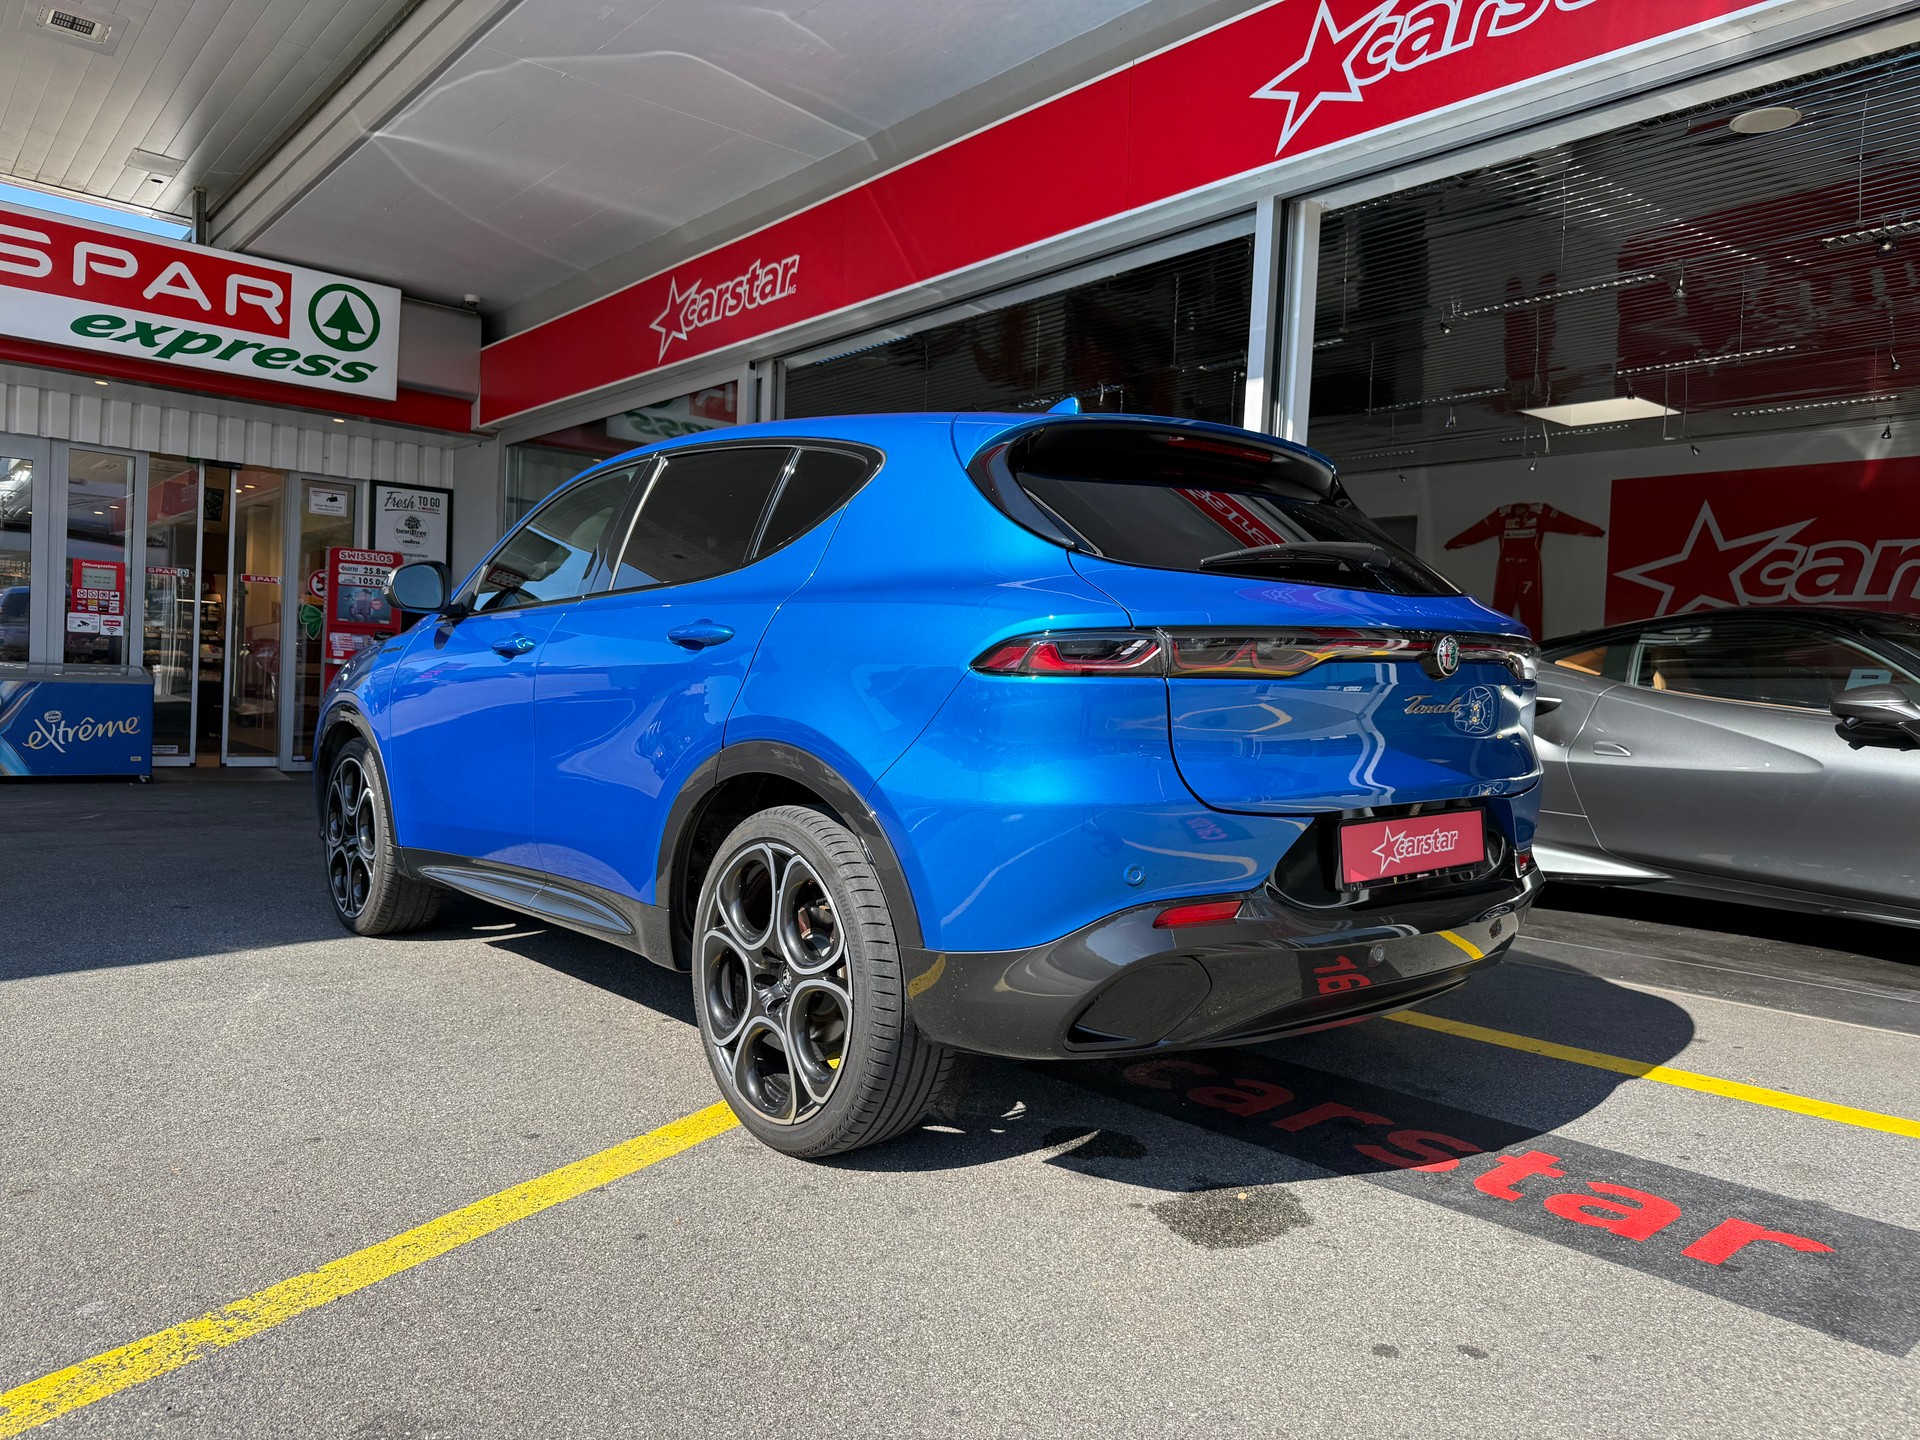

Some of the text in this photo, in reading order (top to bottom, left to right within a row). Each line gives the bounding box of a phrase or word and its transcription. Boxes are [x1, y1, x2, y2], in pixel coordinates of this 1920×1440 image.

[0, 223, 284, 325] SPAR
[680, 254, 800, 332] carstar AG
[70, 313, 378, 384] express
[384, 491, 416, 510] Fresh
[418, 496, 429, 507] TO
[430, 497, 440, 508] GO
[340, 550, 393, 564] SWISSLOS
[147, 567, 178, 576] SPAR
[249, 575, 277, 584] SPAR
[1729, 539, 1920, 604] car
[1522, 580, 1533, 595] 7
[1403, 694, 1462, 715] Tonale
[1394, 827, 1459, 860] carstar
[1122, 1059, 1837, 1266] carstar
